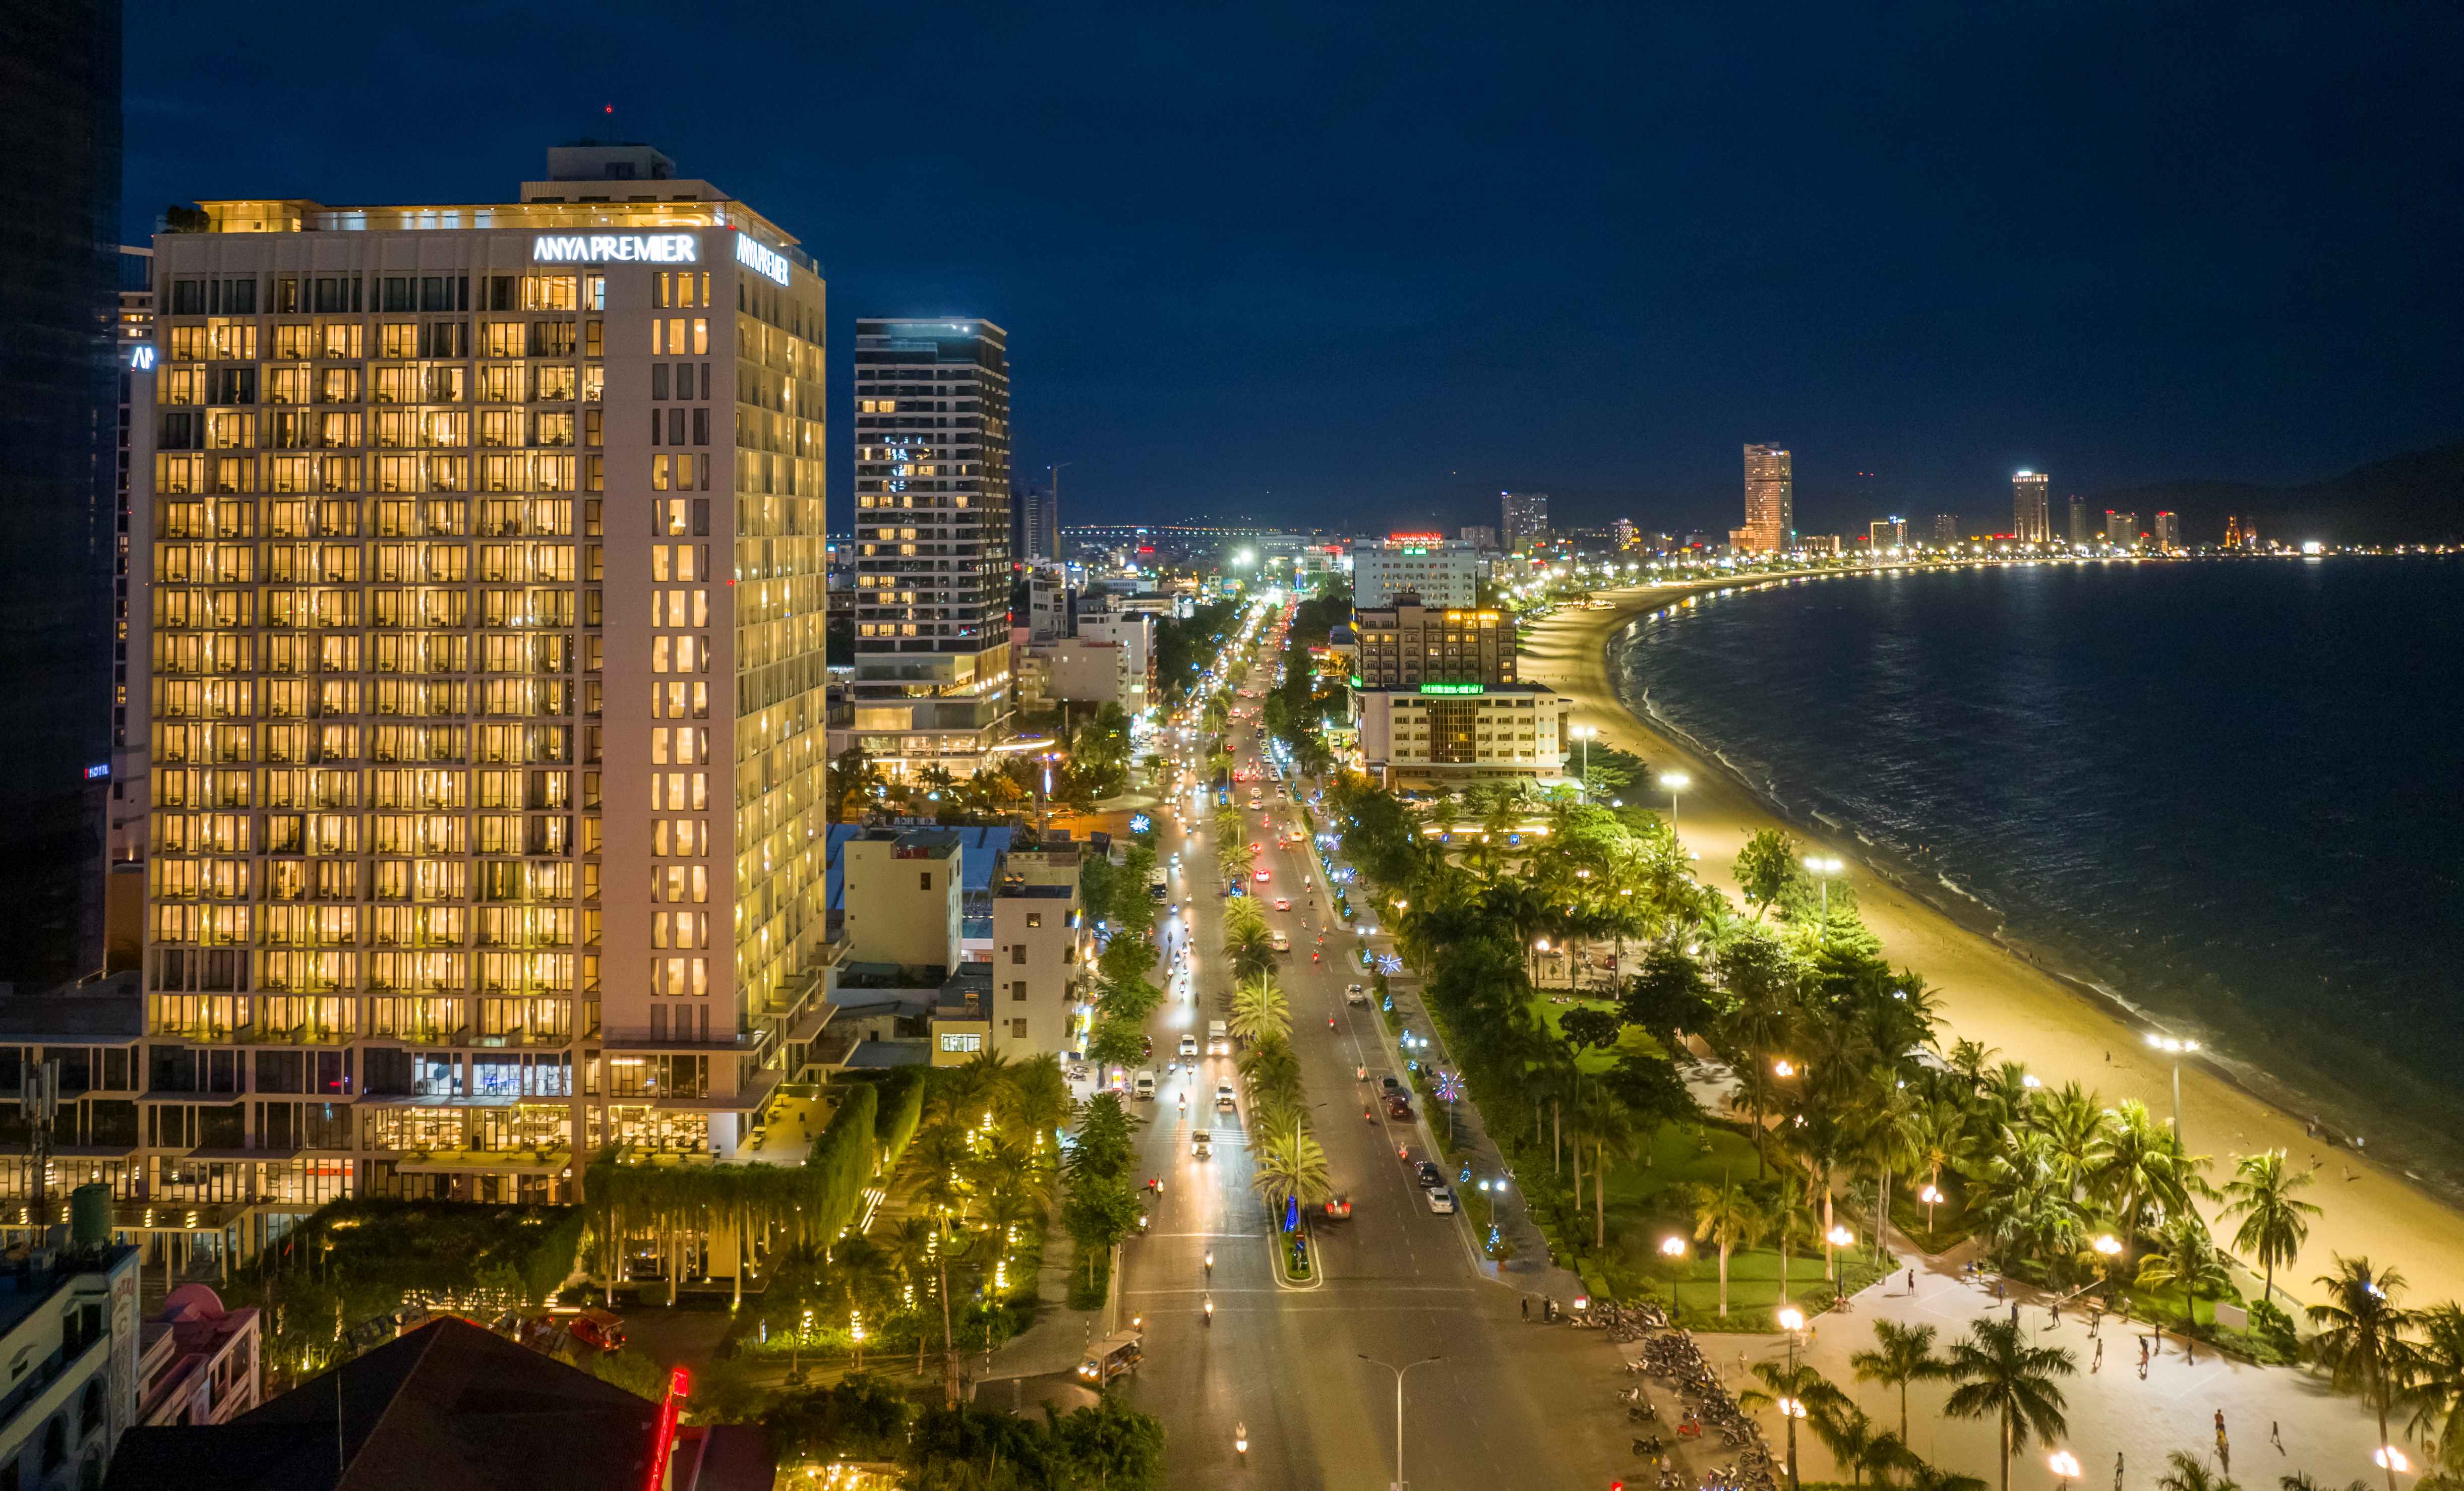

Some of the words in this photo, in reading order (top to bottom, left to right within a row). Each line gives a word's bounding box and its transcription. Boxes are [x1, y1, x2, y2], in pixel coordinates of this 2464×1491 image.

[533, 236, 589, 261] ANYA
[590, 234, 696, 261] PREMIER
[736, 232, 758, 271] ANYA
[758, 244, 789, 287] PREMIER
